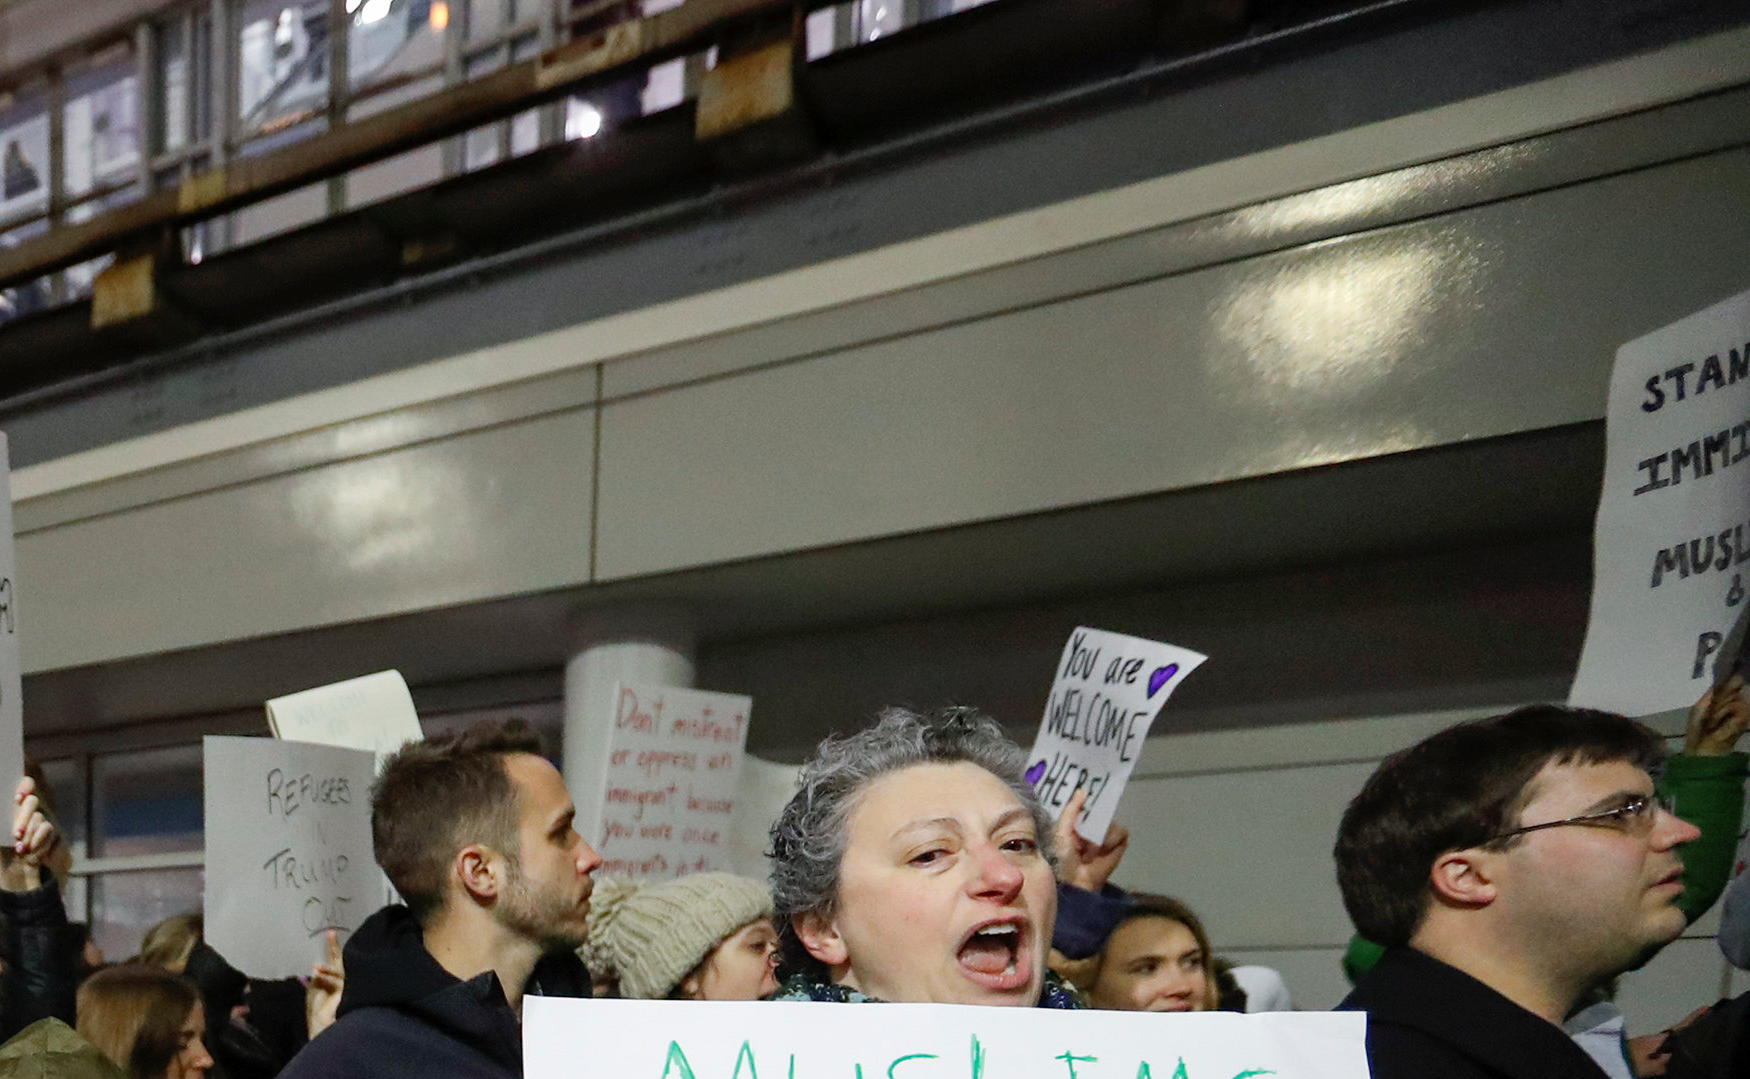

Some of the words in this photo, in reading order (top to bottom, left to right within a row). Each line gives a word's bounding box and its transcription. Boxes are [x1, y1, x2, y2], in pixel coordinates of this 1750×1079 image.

[1650, 519, 1750, 588] MUSL
[1104, 656, 1146, 684] are
[1047, 688, 1148, 763] WELCOME
[1037, 751, 1111, 823] HERE!
[263, 847, 349, 890] TRUMP
